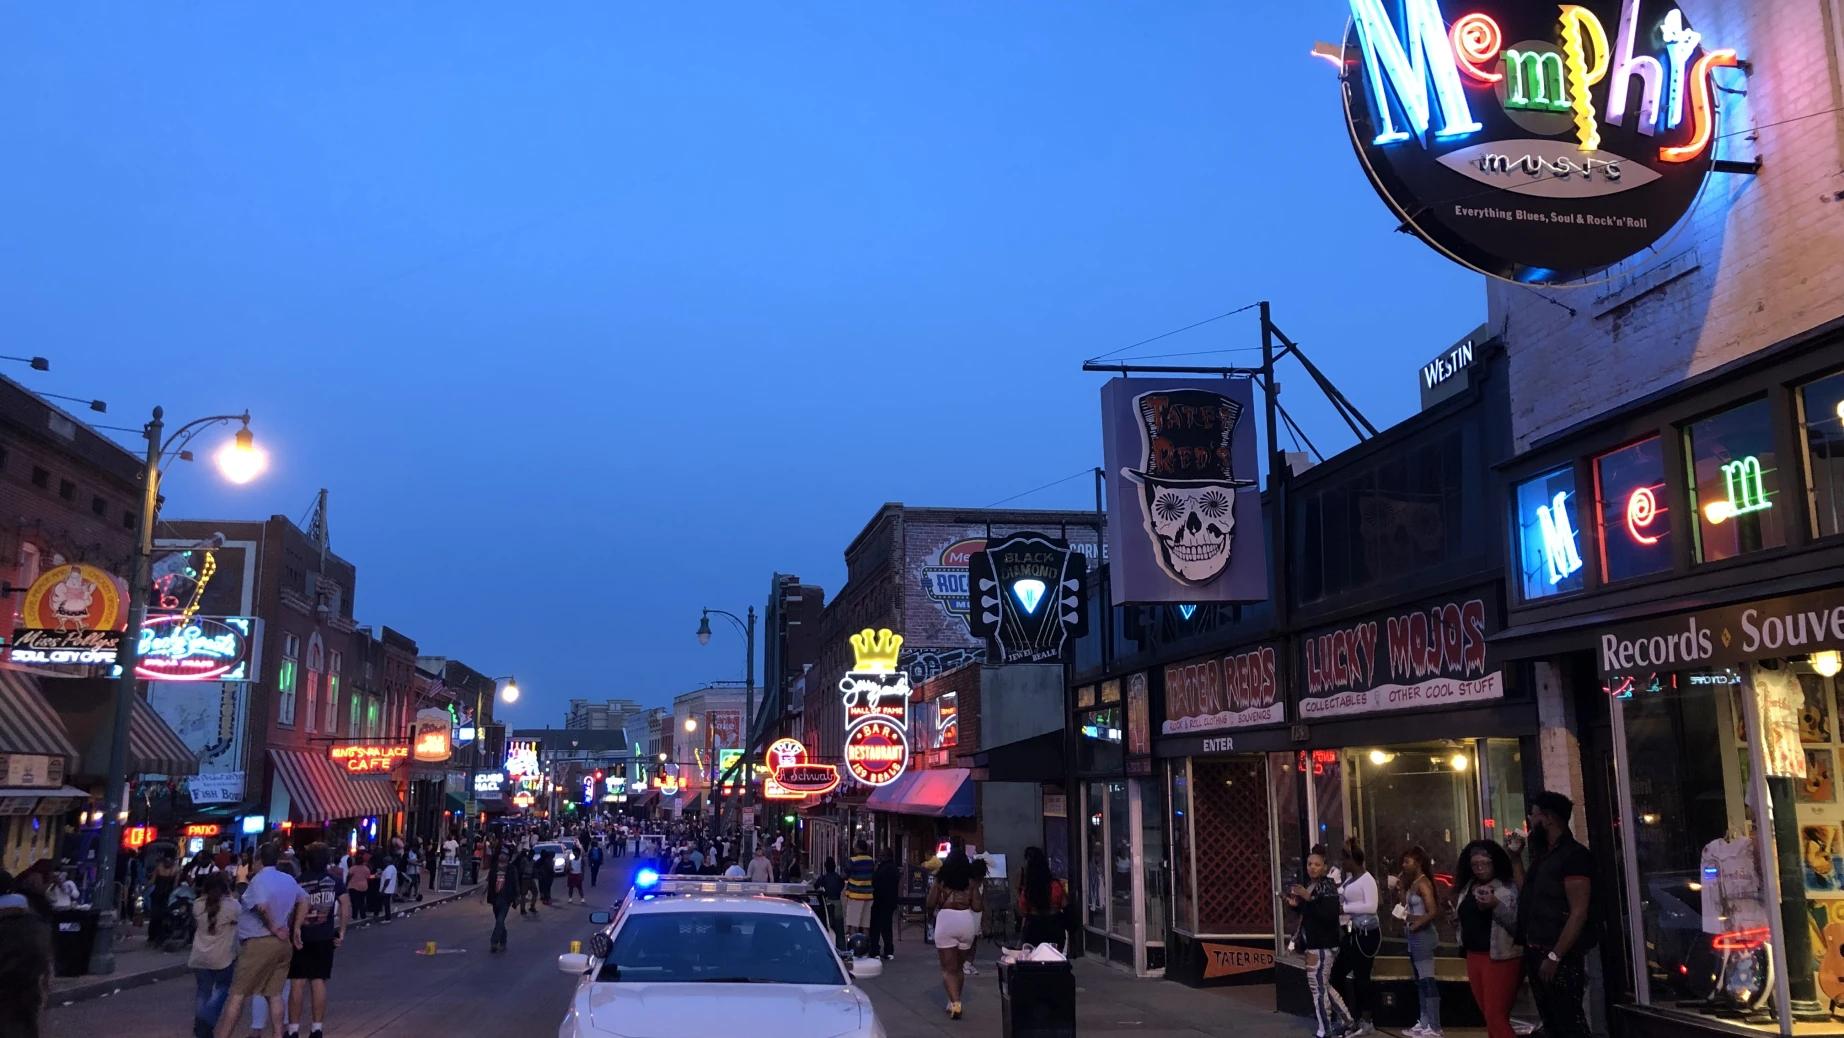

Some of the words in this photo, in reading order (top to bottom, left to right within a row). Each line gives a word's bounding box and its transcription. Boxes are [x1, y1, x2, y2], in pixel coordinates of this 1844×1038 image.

[1349, 0, 1738, 163] Memphis
[1479, 153, 1622, 182] music
[1455, 205, 1513, 221] Everything
[1515, 209, 1549, 223] Blues,
[1550, 211, 1574, 224] Soul
[1576, 213, 1585, 224] &
[1586, 214, 1648, 229] Rock'n'Roll
[1424, 340, 1473, 389] WESTIN
[1145, 396, 1233, 432] TATER
[1154, 436, 1231, 475] RED'S
[1536, 490, 1583, 585] M
[1004, 552, 1054, 564] BLACK
[1001, 563, 1058, 580] DIAMOND
[936, 574, 970, 593] ROC
[14, 630, 62, 648] Miss
[1306, 621, 1377, 694] LUCKY
[1387, 599, 1487, 680] MOJOS
[1601, 616, 1713, 672] Records
[11, 650, 50, 663] SOUL
[50, 651, 80, 663] CITY
[80, 651, 118, 664] CAFE
[1031, 648, 1058, 662] BEALE
[1167, 660, 1221, 714] TATER
[1305, 693, 1368, 713] COLLECTABLES
[1389, 686, 1421, 703] OTHER
[1425, 682, 1454, 699] COOL
[1458, 676, 1495, 696] STUFF
[850, 707, 870, 715] HALL
[871, 707, 881, 715] OF
[883, 707, 903, 715] FAME
[1237, 709, 1271, 723] SOUVENIRS
[863, 723, 890, 738] BAR
[848, 744, 904, 761] RESTAURANT
[1203, 737, 1234, 752] ENTER
[348, 758, 392, 771] CAFE
[852, 763, 868, 778] 159
[790, 767, 835, 782] Schwab
[191, 788, 219, 800] FISH
[188, 825, 218, 837] PATIO
[1212, 950, 1251, 967] TATER
[1253, 953, 1274, 965] RED
